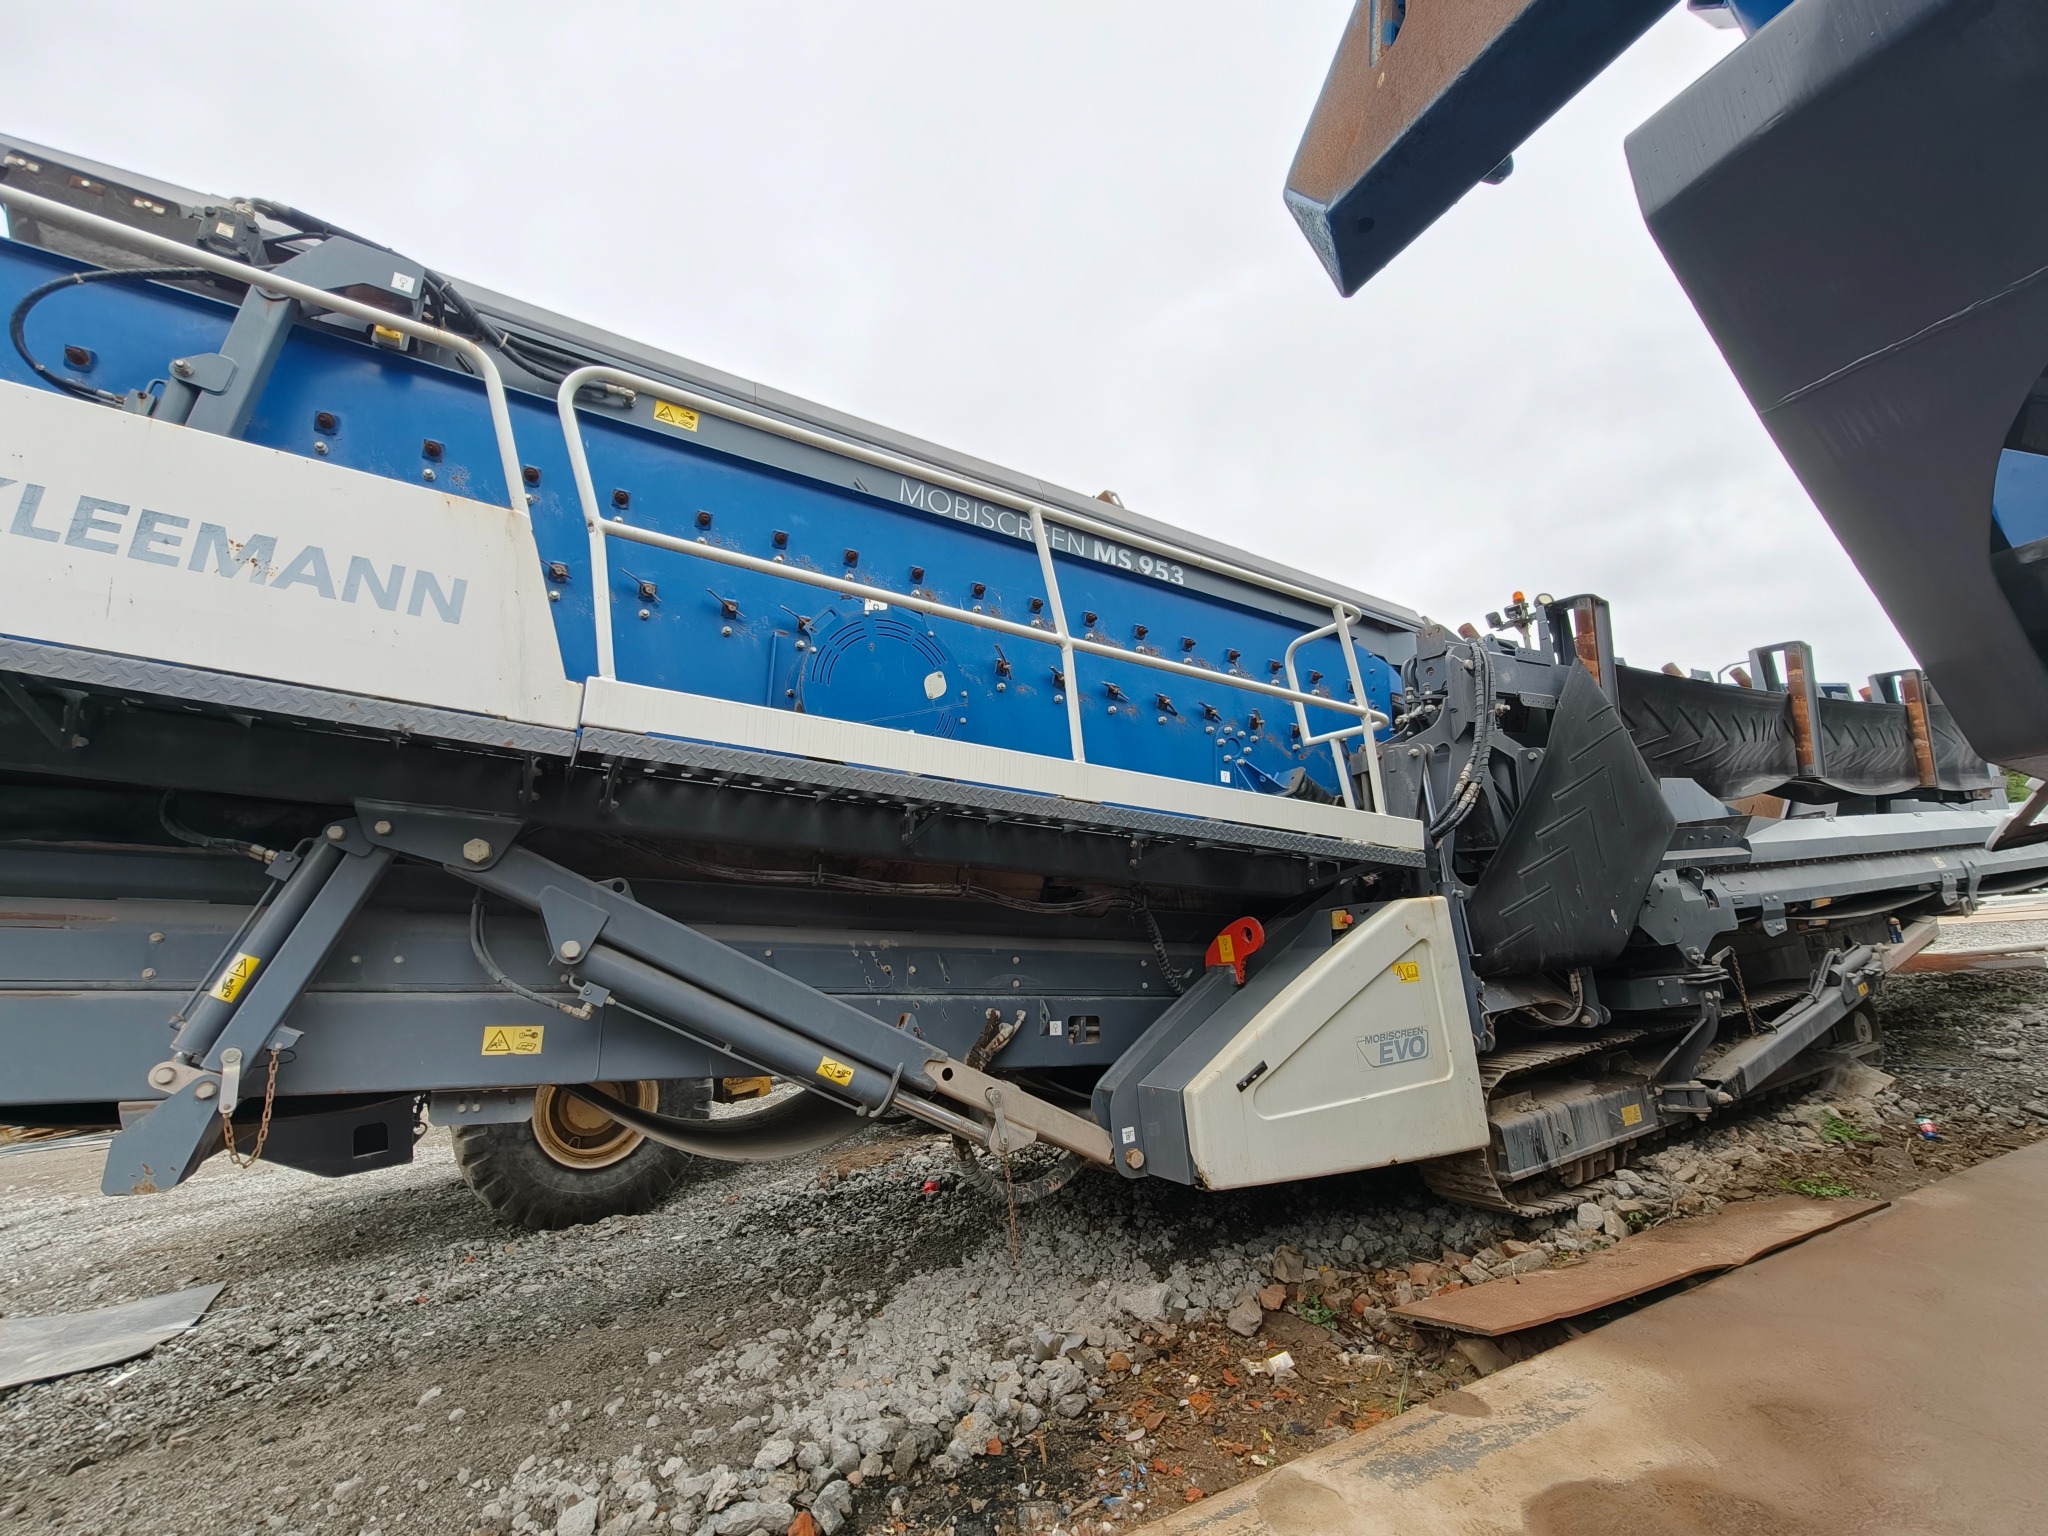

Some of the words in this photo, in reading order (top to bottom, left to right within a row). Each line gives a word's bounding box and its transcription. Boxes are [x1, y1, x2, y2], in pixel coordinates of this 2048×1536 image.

[0, 477, 468, 624] LEEMANN
[1094, 540, 1132, 570] MS
[1138, 555, 1184, 586] 953
[1364, 1026, 1424, 1045] MOBISCREEN
[1379, 1036, 1426, 1064] EVO
